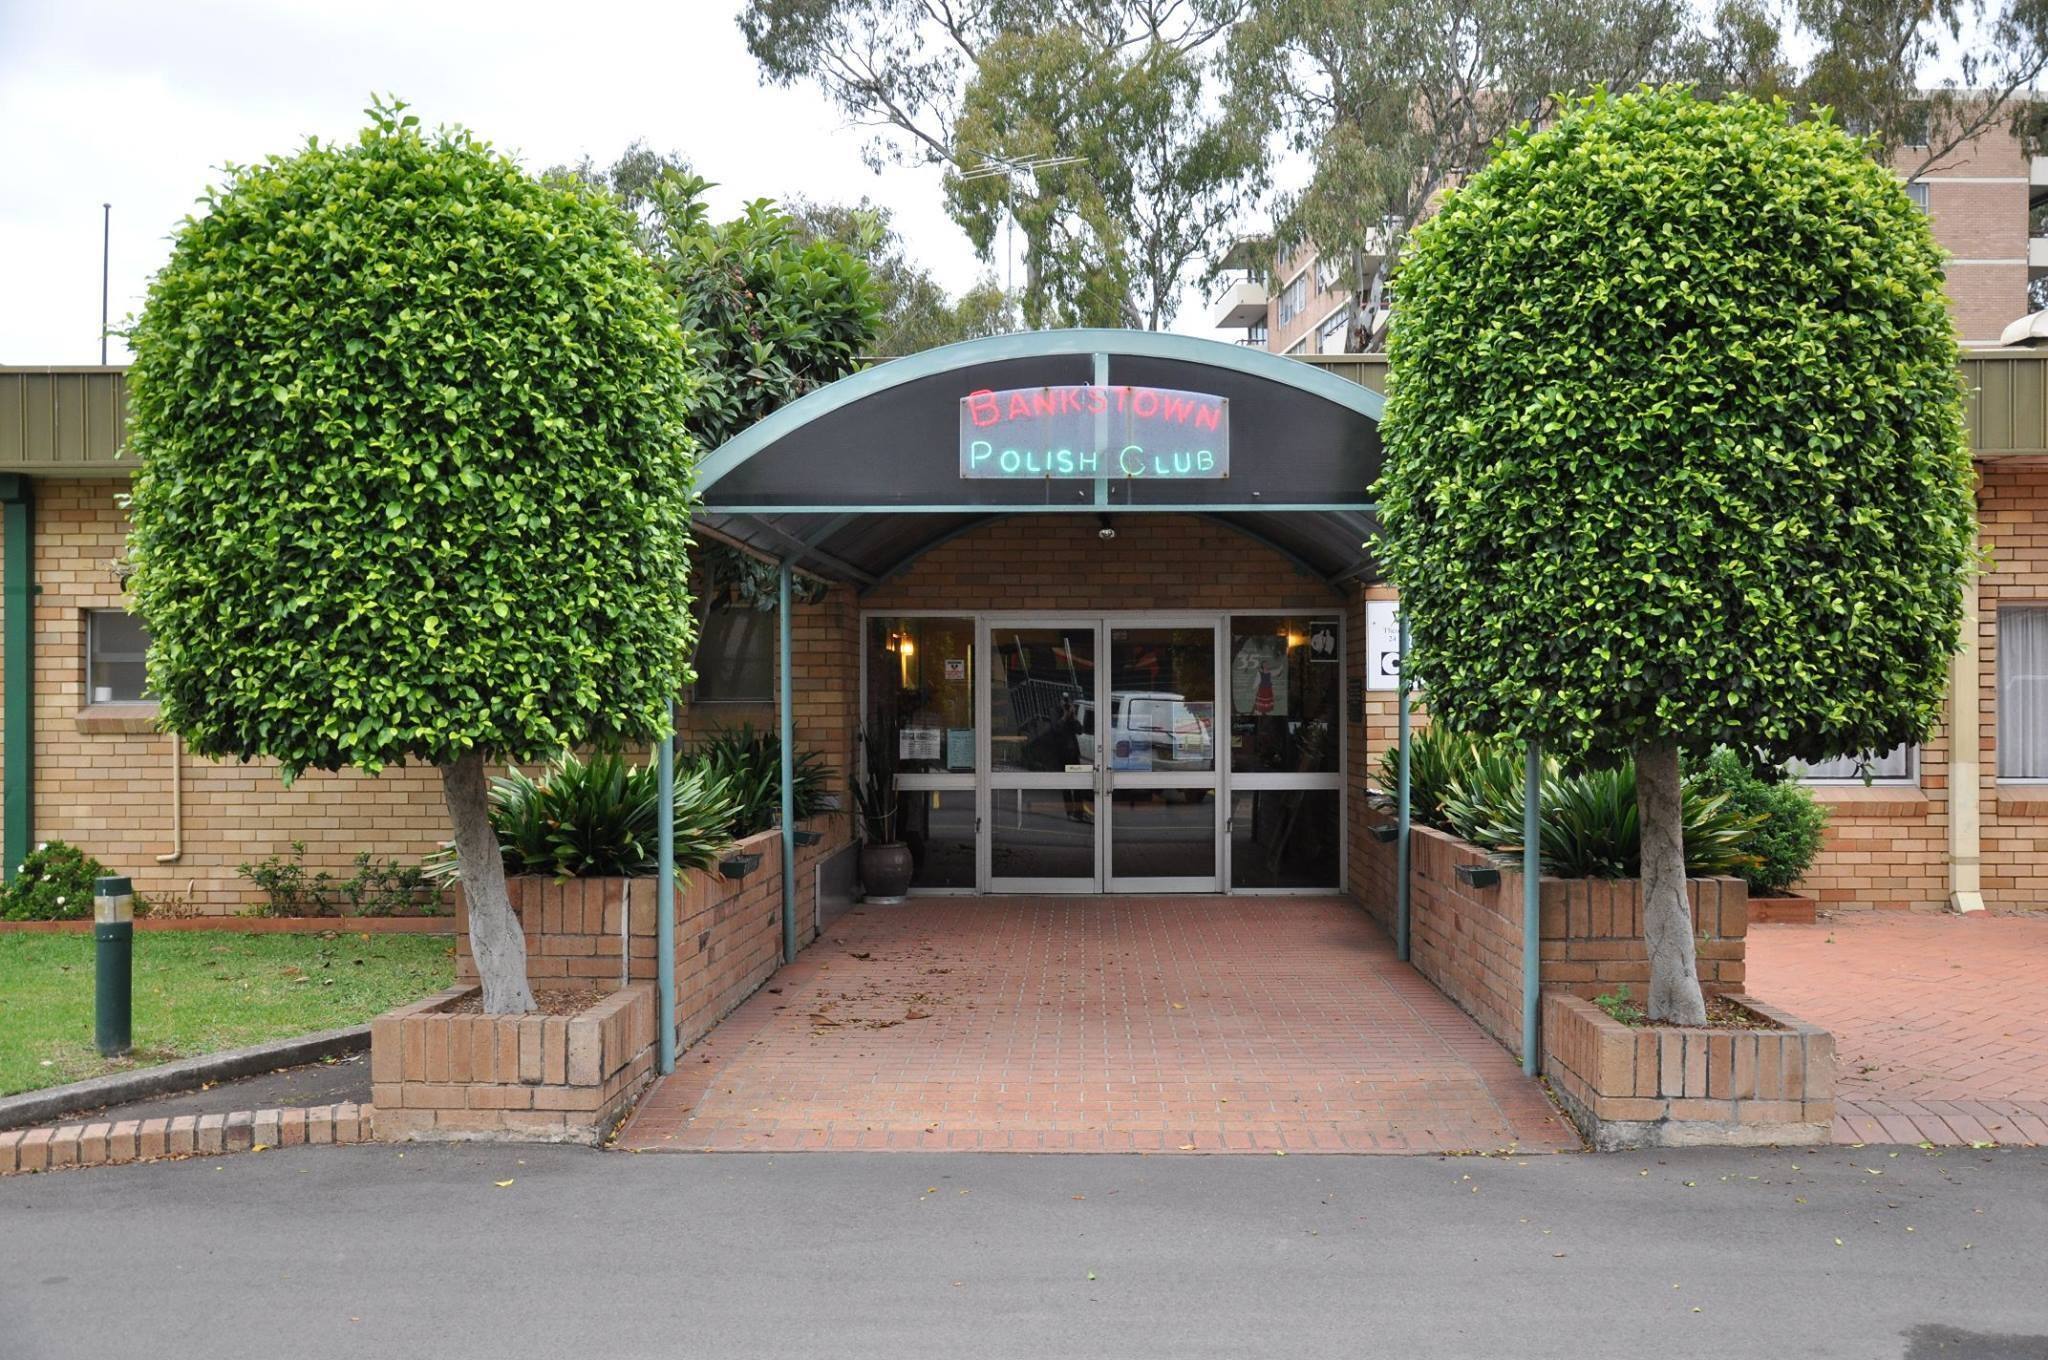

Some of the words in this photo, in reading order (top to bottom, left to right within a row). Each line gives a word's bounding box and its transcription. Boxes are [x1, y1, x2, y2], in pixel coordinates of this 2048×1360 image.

[968, 388, 1221, 430] BANKSTOWN
[970, 440, 1098, 473] POLISH
[1119, 445, 1216, 476] CLUB
[1237, 654, 1259, 669] 35
